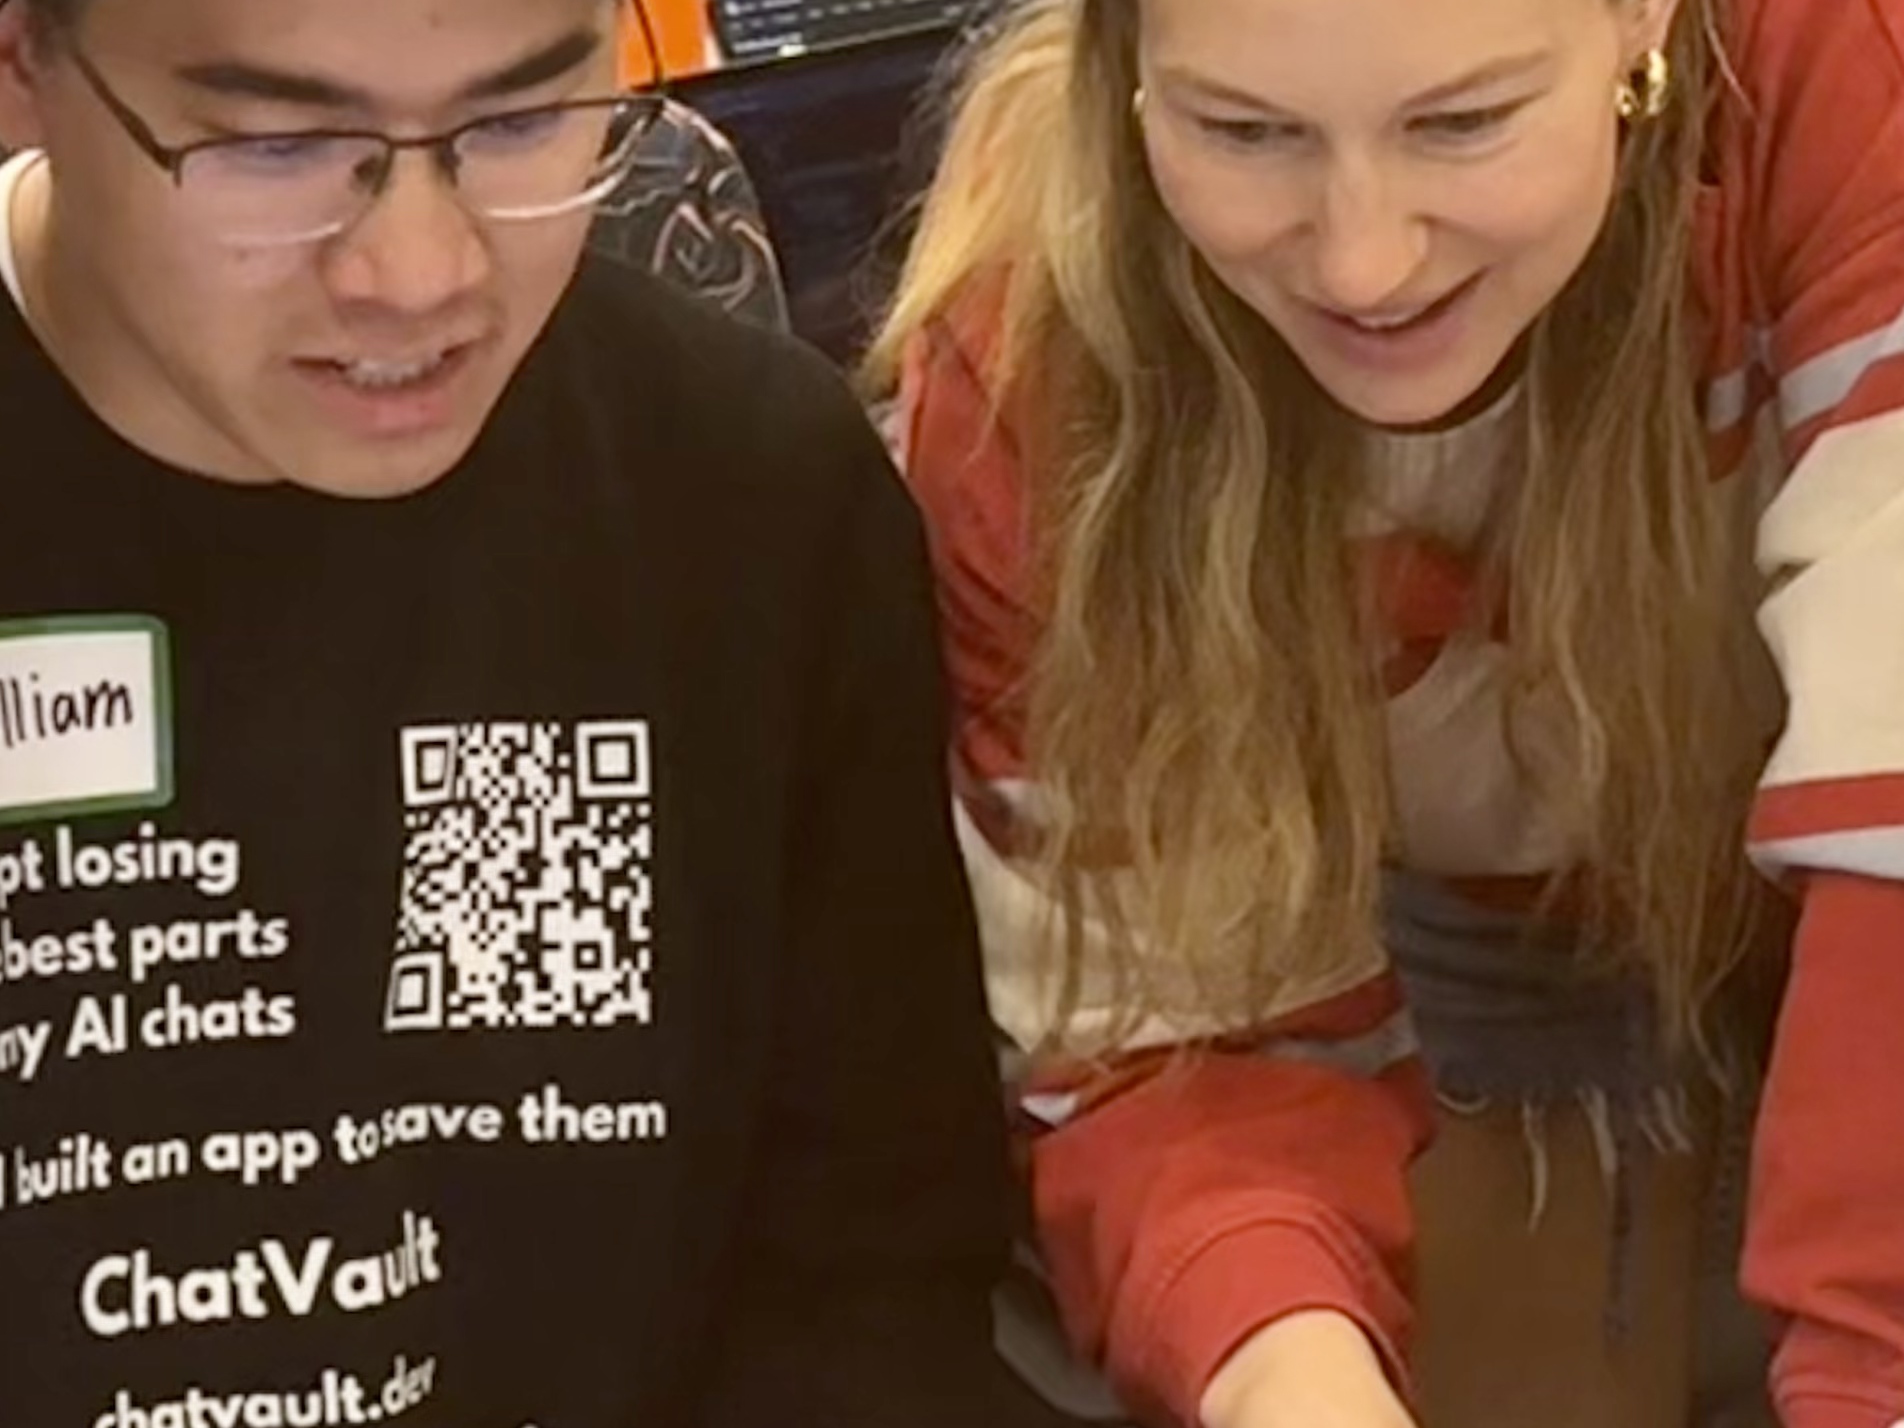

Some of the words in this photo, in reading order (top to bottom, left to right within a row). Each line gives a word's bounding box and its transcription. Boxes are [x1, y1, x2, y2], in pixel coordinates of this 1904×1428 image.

[56, 820, 240, 895] losing
[129, 908, 289, 984] parts
[65, 993, 127, 1058] AI
[141, 983, 297, 1049] chats
[14, 1132, 112, 1204] built
[121, 1138, 191, 1184] an
[200, 1128, 321, 1186] app
[517, 1082, 667, 1143] them
[80, 1209, 442, 1336] ChatVault
